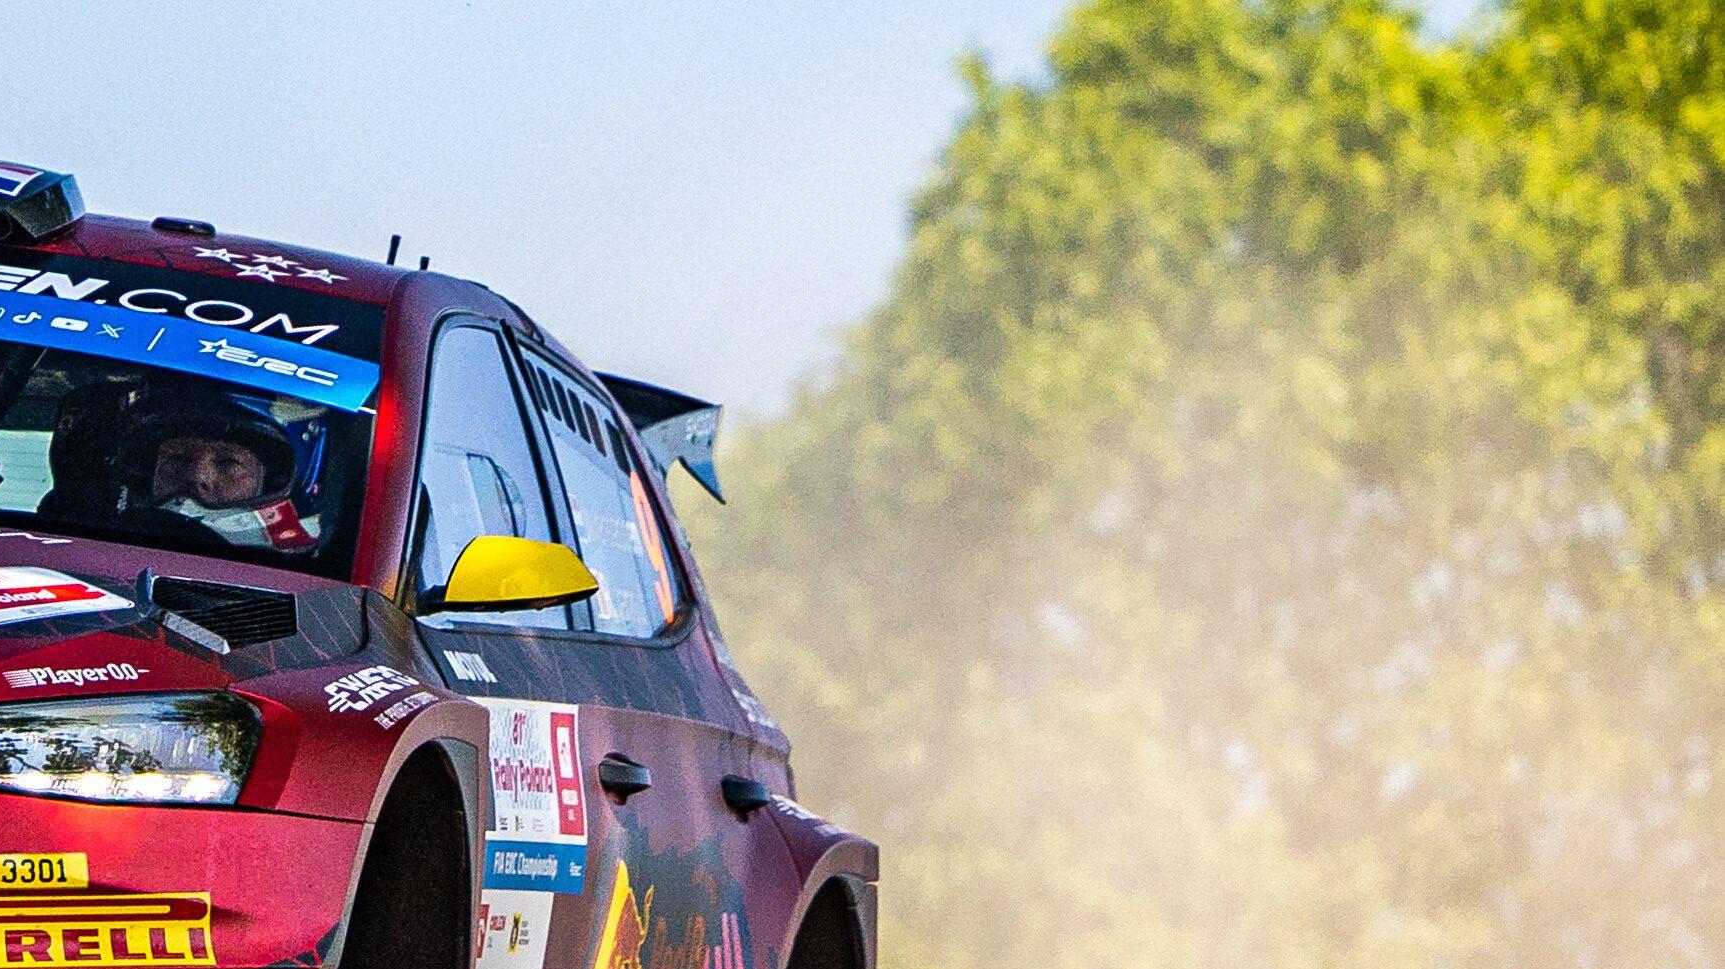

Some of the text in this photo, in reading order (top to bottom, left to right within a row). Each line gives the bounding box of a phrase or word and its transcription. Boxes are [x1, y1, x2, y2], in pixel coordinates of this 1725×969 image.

[493, 756, 553, 803] Rally Poland
[1, 858, 68, 883] 3301
